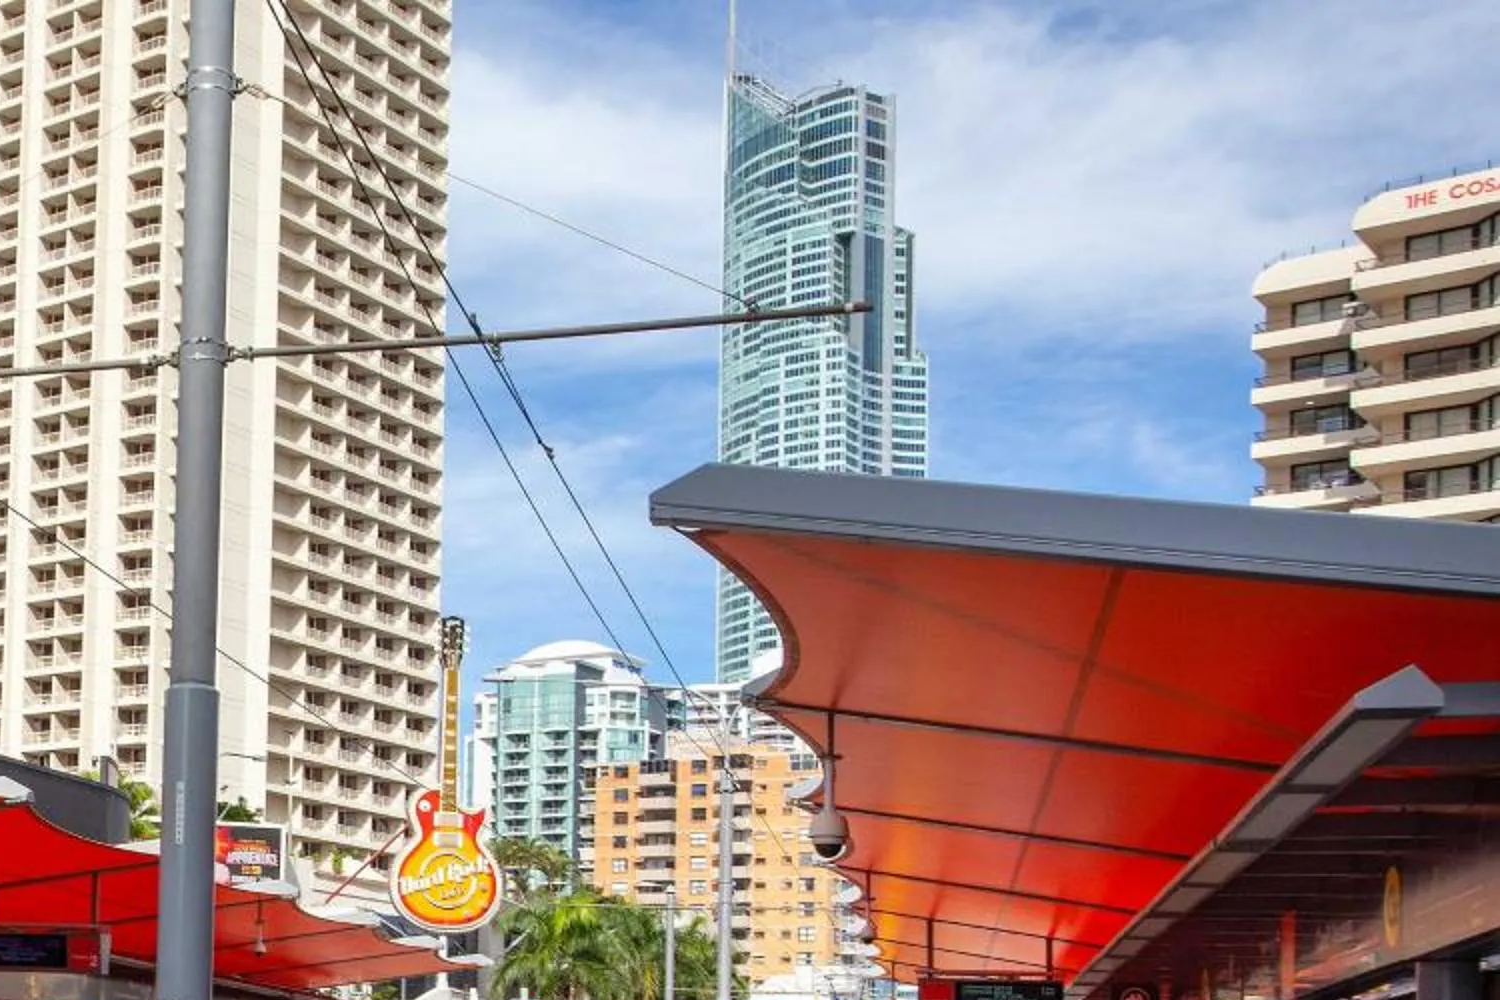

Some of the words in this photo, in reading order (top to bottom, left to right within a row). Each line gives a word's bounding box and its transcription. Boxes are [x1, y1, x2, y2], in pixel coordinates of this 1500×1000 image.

[1404, 189, 1438, 209] THE
[1448, 177, 1500, 199] COS
[400, 866, 445, 896] Hard
[447, 854, 492, 884] Rock
